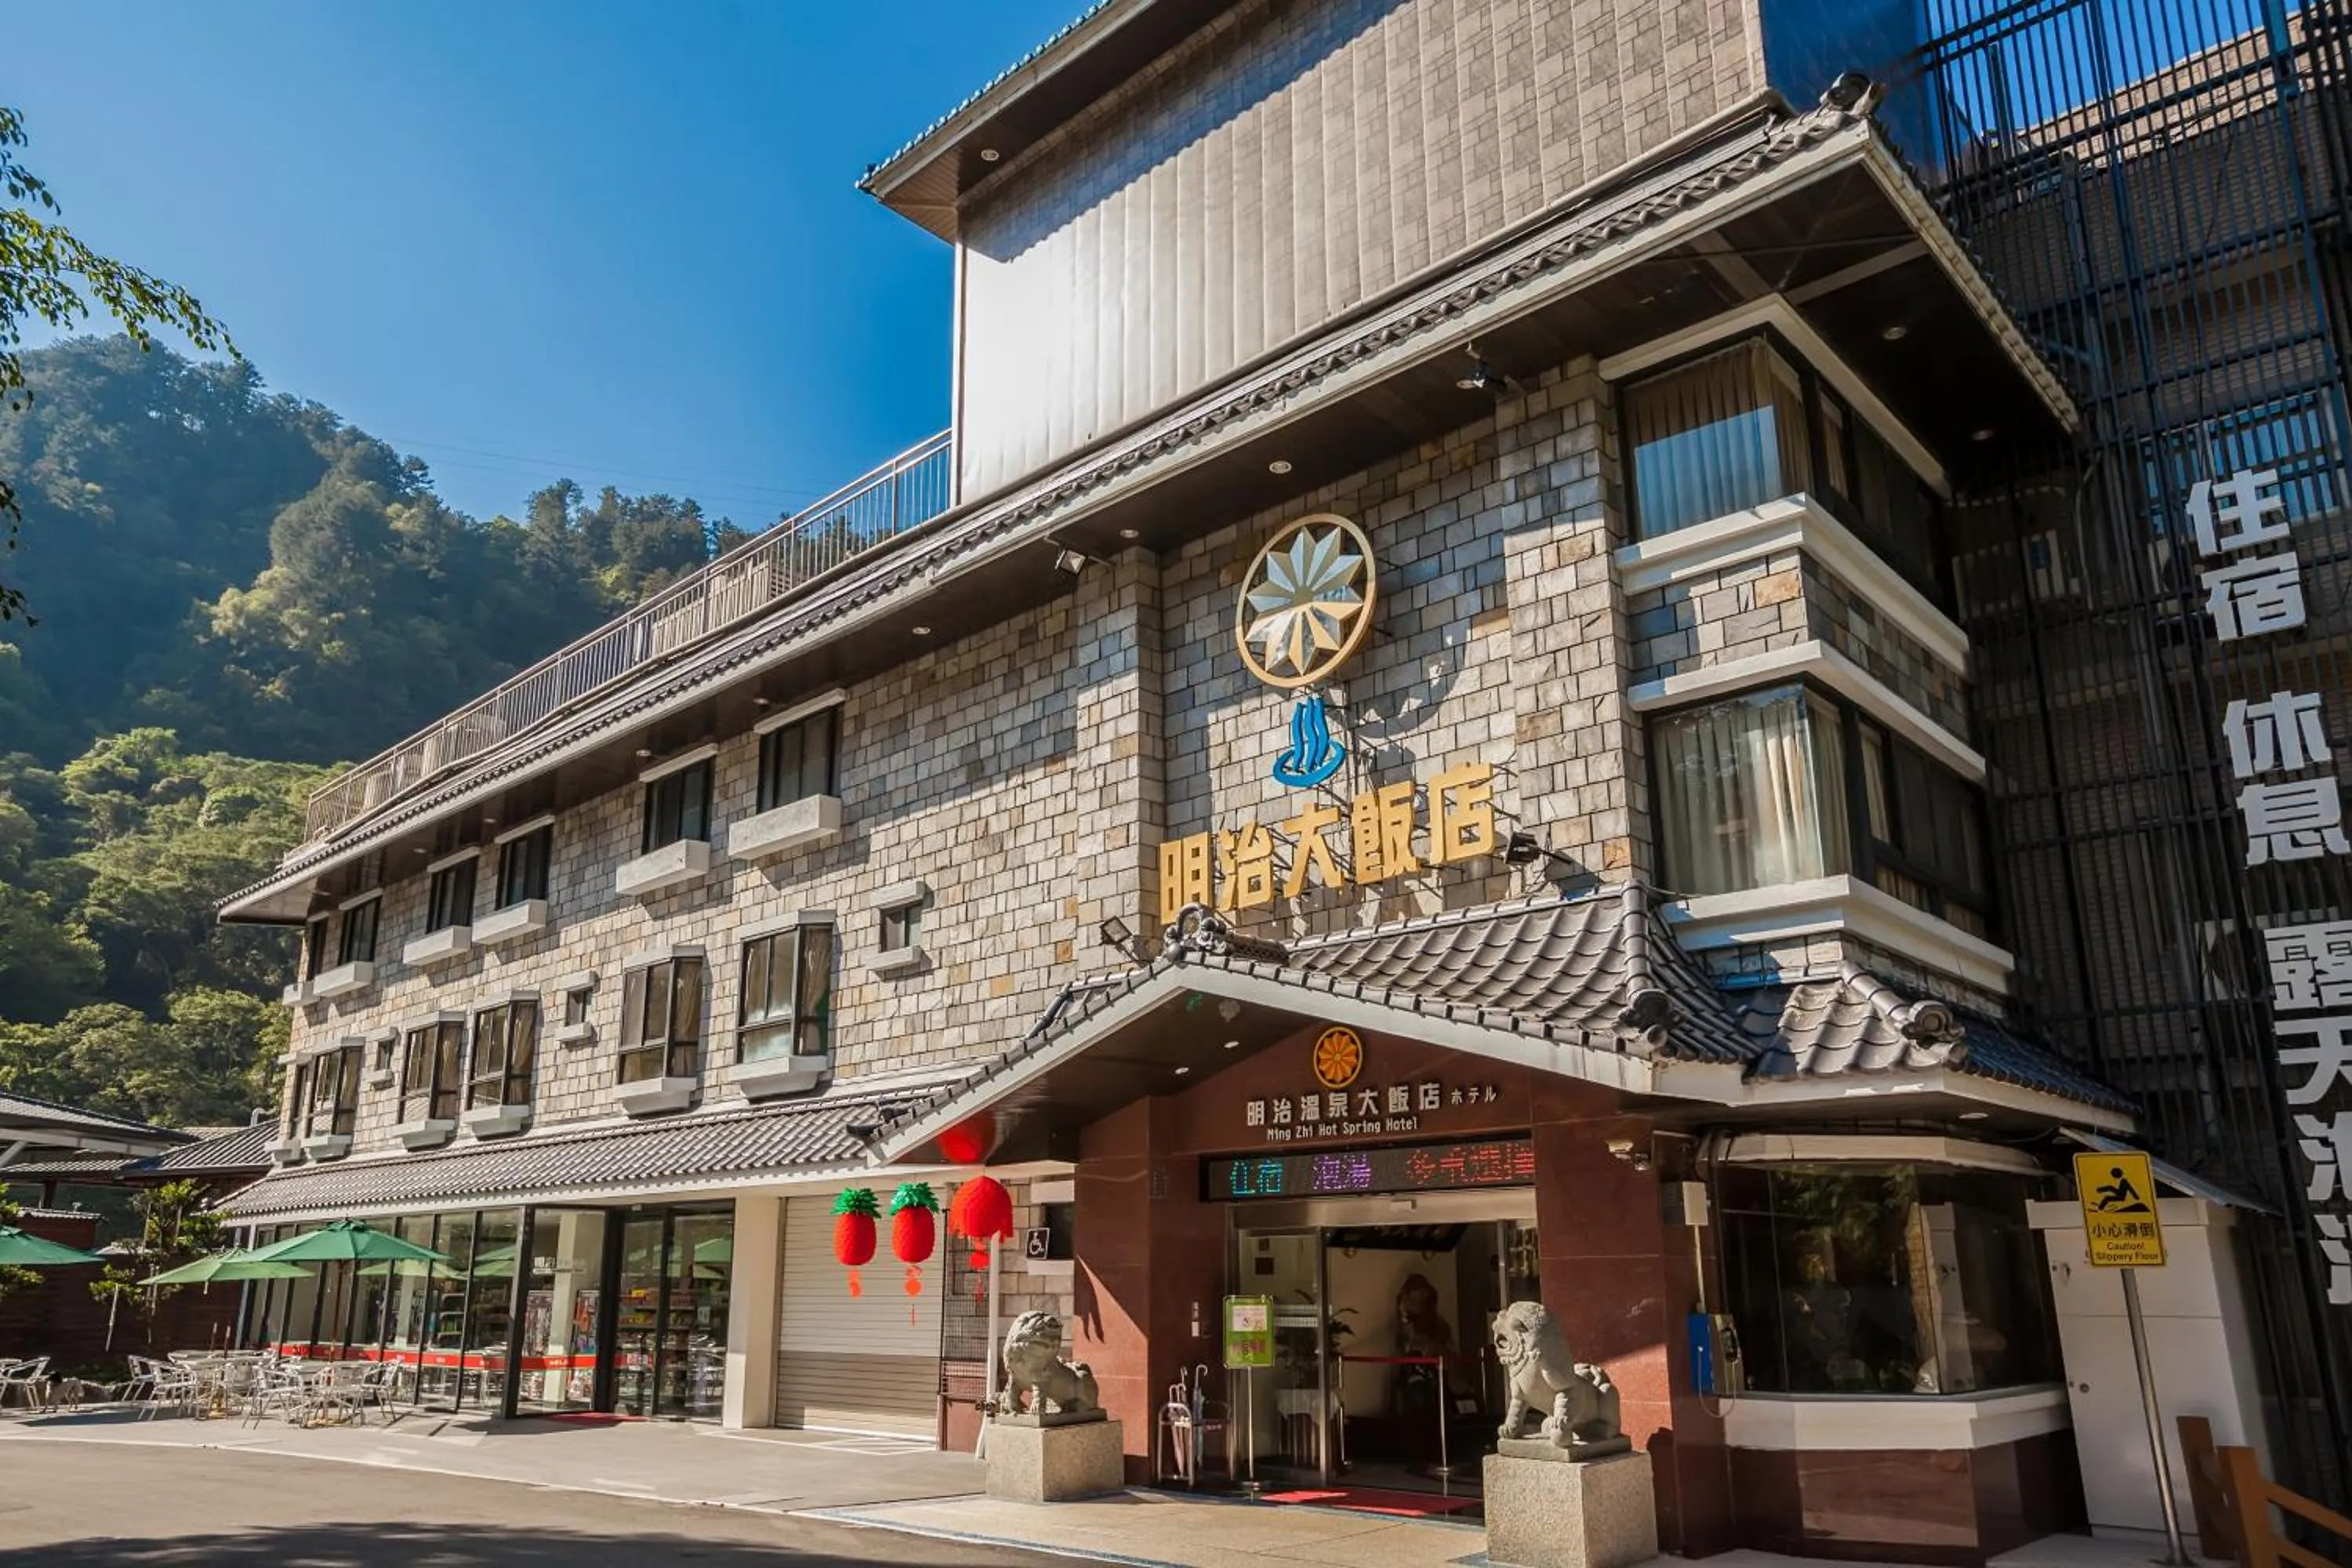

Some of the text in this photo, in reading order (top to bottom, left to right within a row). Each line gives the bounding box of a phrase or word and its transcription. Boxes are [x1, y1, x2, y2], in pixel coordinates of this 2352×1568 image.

[2186, 468, 2307, 641] 住宿
[2223, 691, 2350, 866] 休息
[1160, 761, 1495, 925] 明治大飯店
[1267, 1116, 1418, 1141] Ming Zhi Hot Spring Hotel
[1450, 1086, 1497, 1105] ホテル
[2092, 1222, 2154, 1239] 小心滑倒
